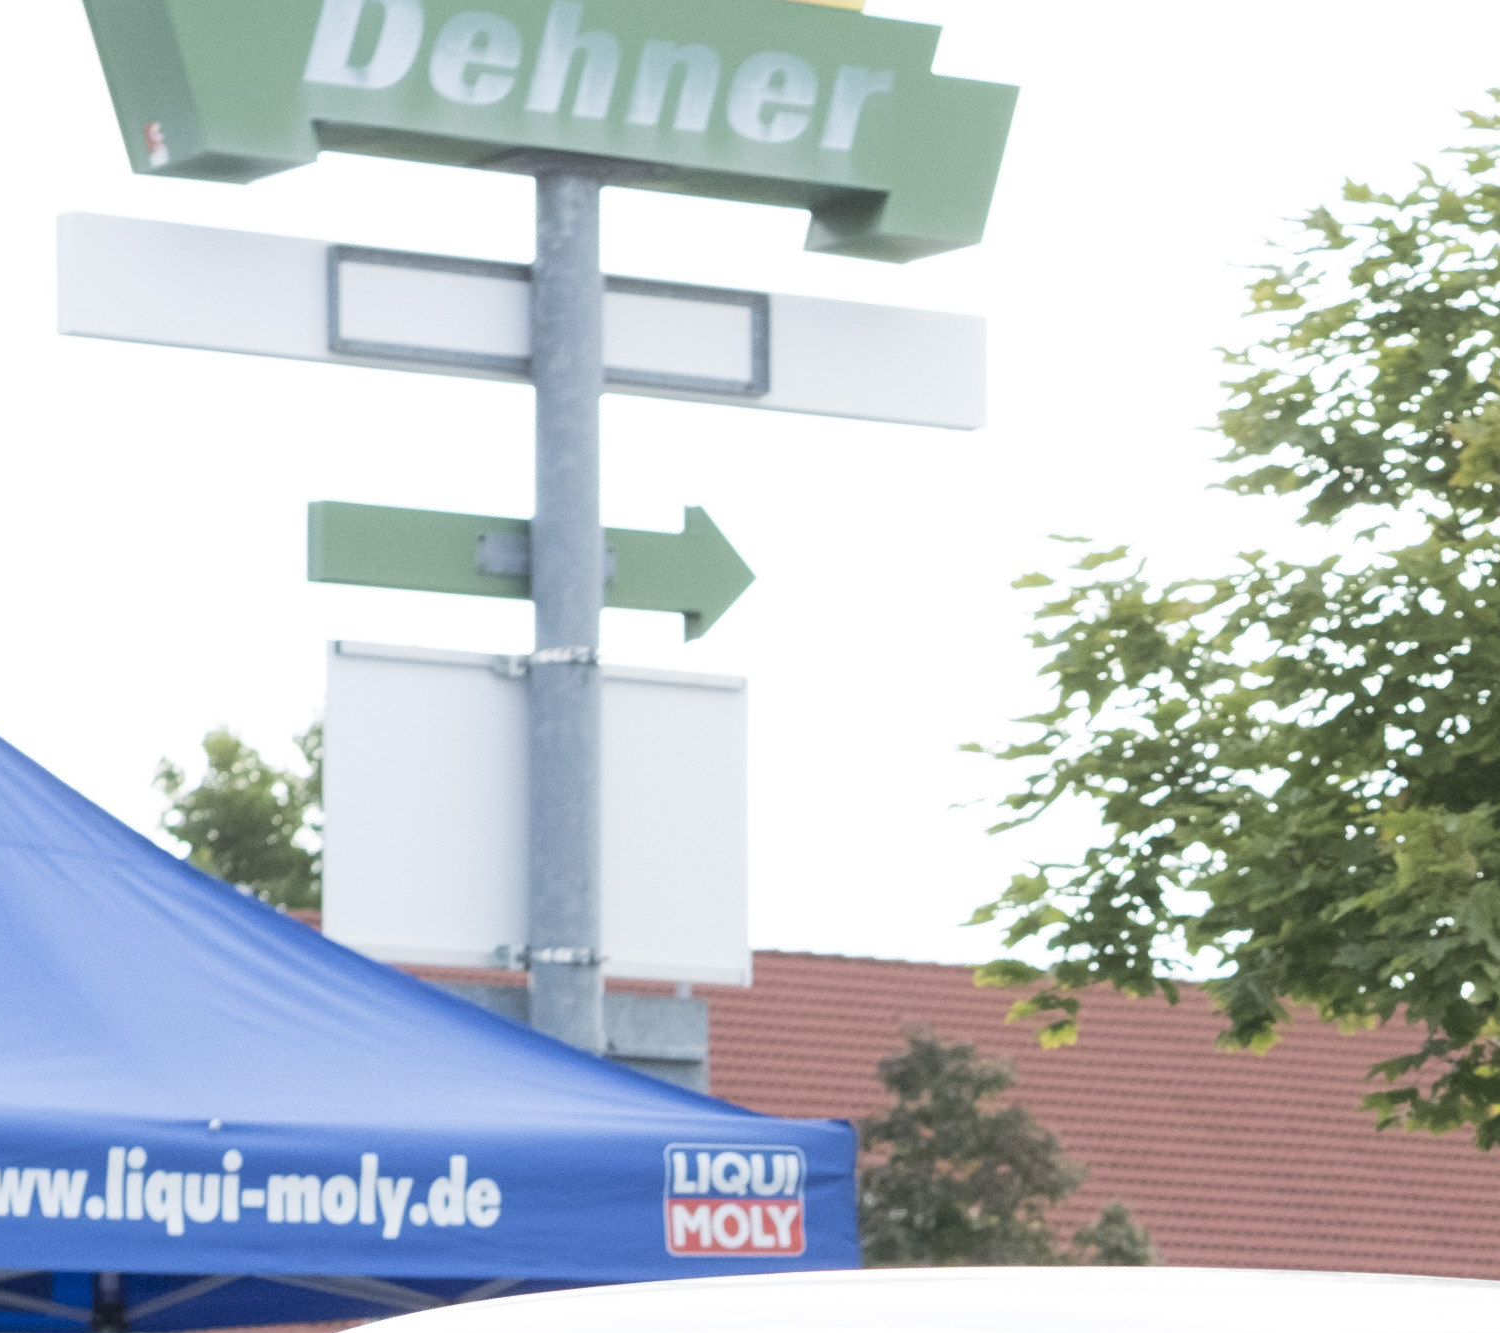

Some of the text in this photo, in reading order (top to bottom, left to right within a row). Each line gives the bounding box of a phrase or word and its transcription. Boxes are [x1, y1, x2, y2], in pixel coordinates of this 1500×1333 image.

[303, 0, 894, 151] Dehner
[672, 1151, 799, 1196] LIQUI
[672, 1203, 799, 1249] MOLY
